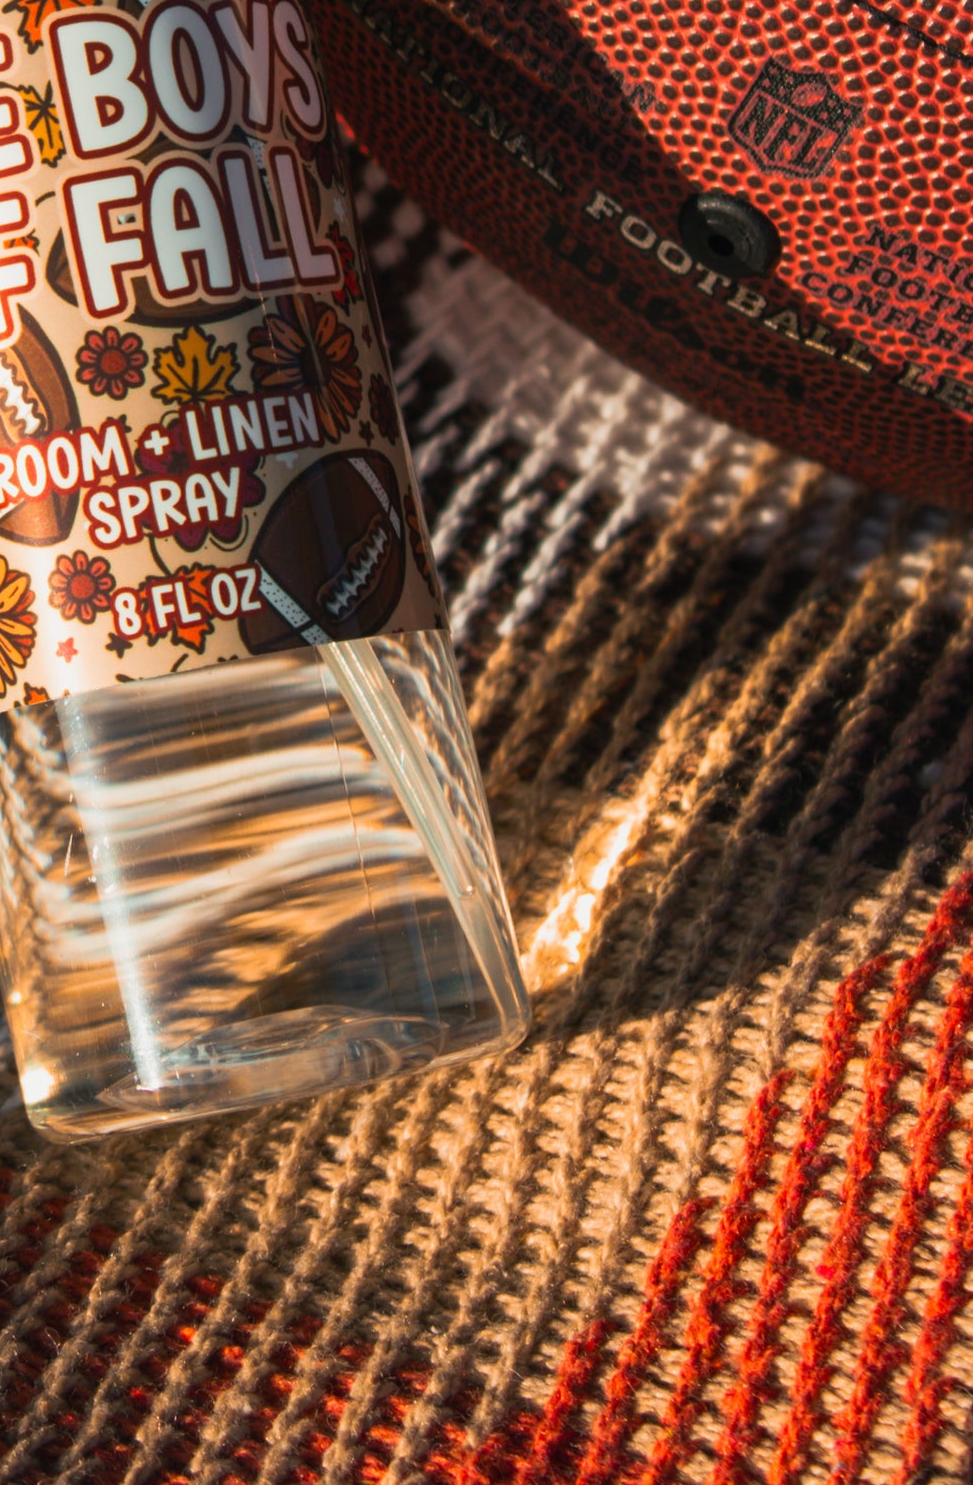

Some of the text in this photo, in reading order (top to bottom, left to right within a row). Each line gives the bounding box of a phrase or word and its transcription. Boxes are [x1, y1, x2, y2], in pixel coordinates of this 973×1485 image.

[736, 91, 827, 172] NFL
[63, 145, 342, 317] FALL
[584, 191, 874, 374] FOOTBALL
[144, 430, 170, 456] +
[185, 392, 320, 460] LINEN
[88, 466, 241, 545] SPRAY
[114, 569, 262, 636] 8 FL OZ
